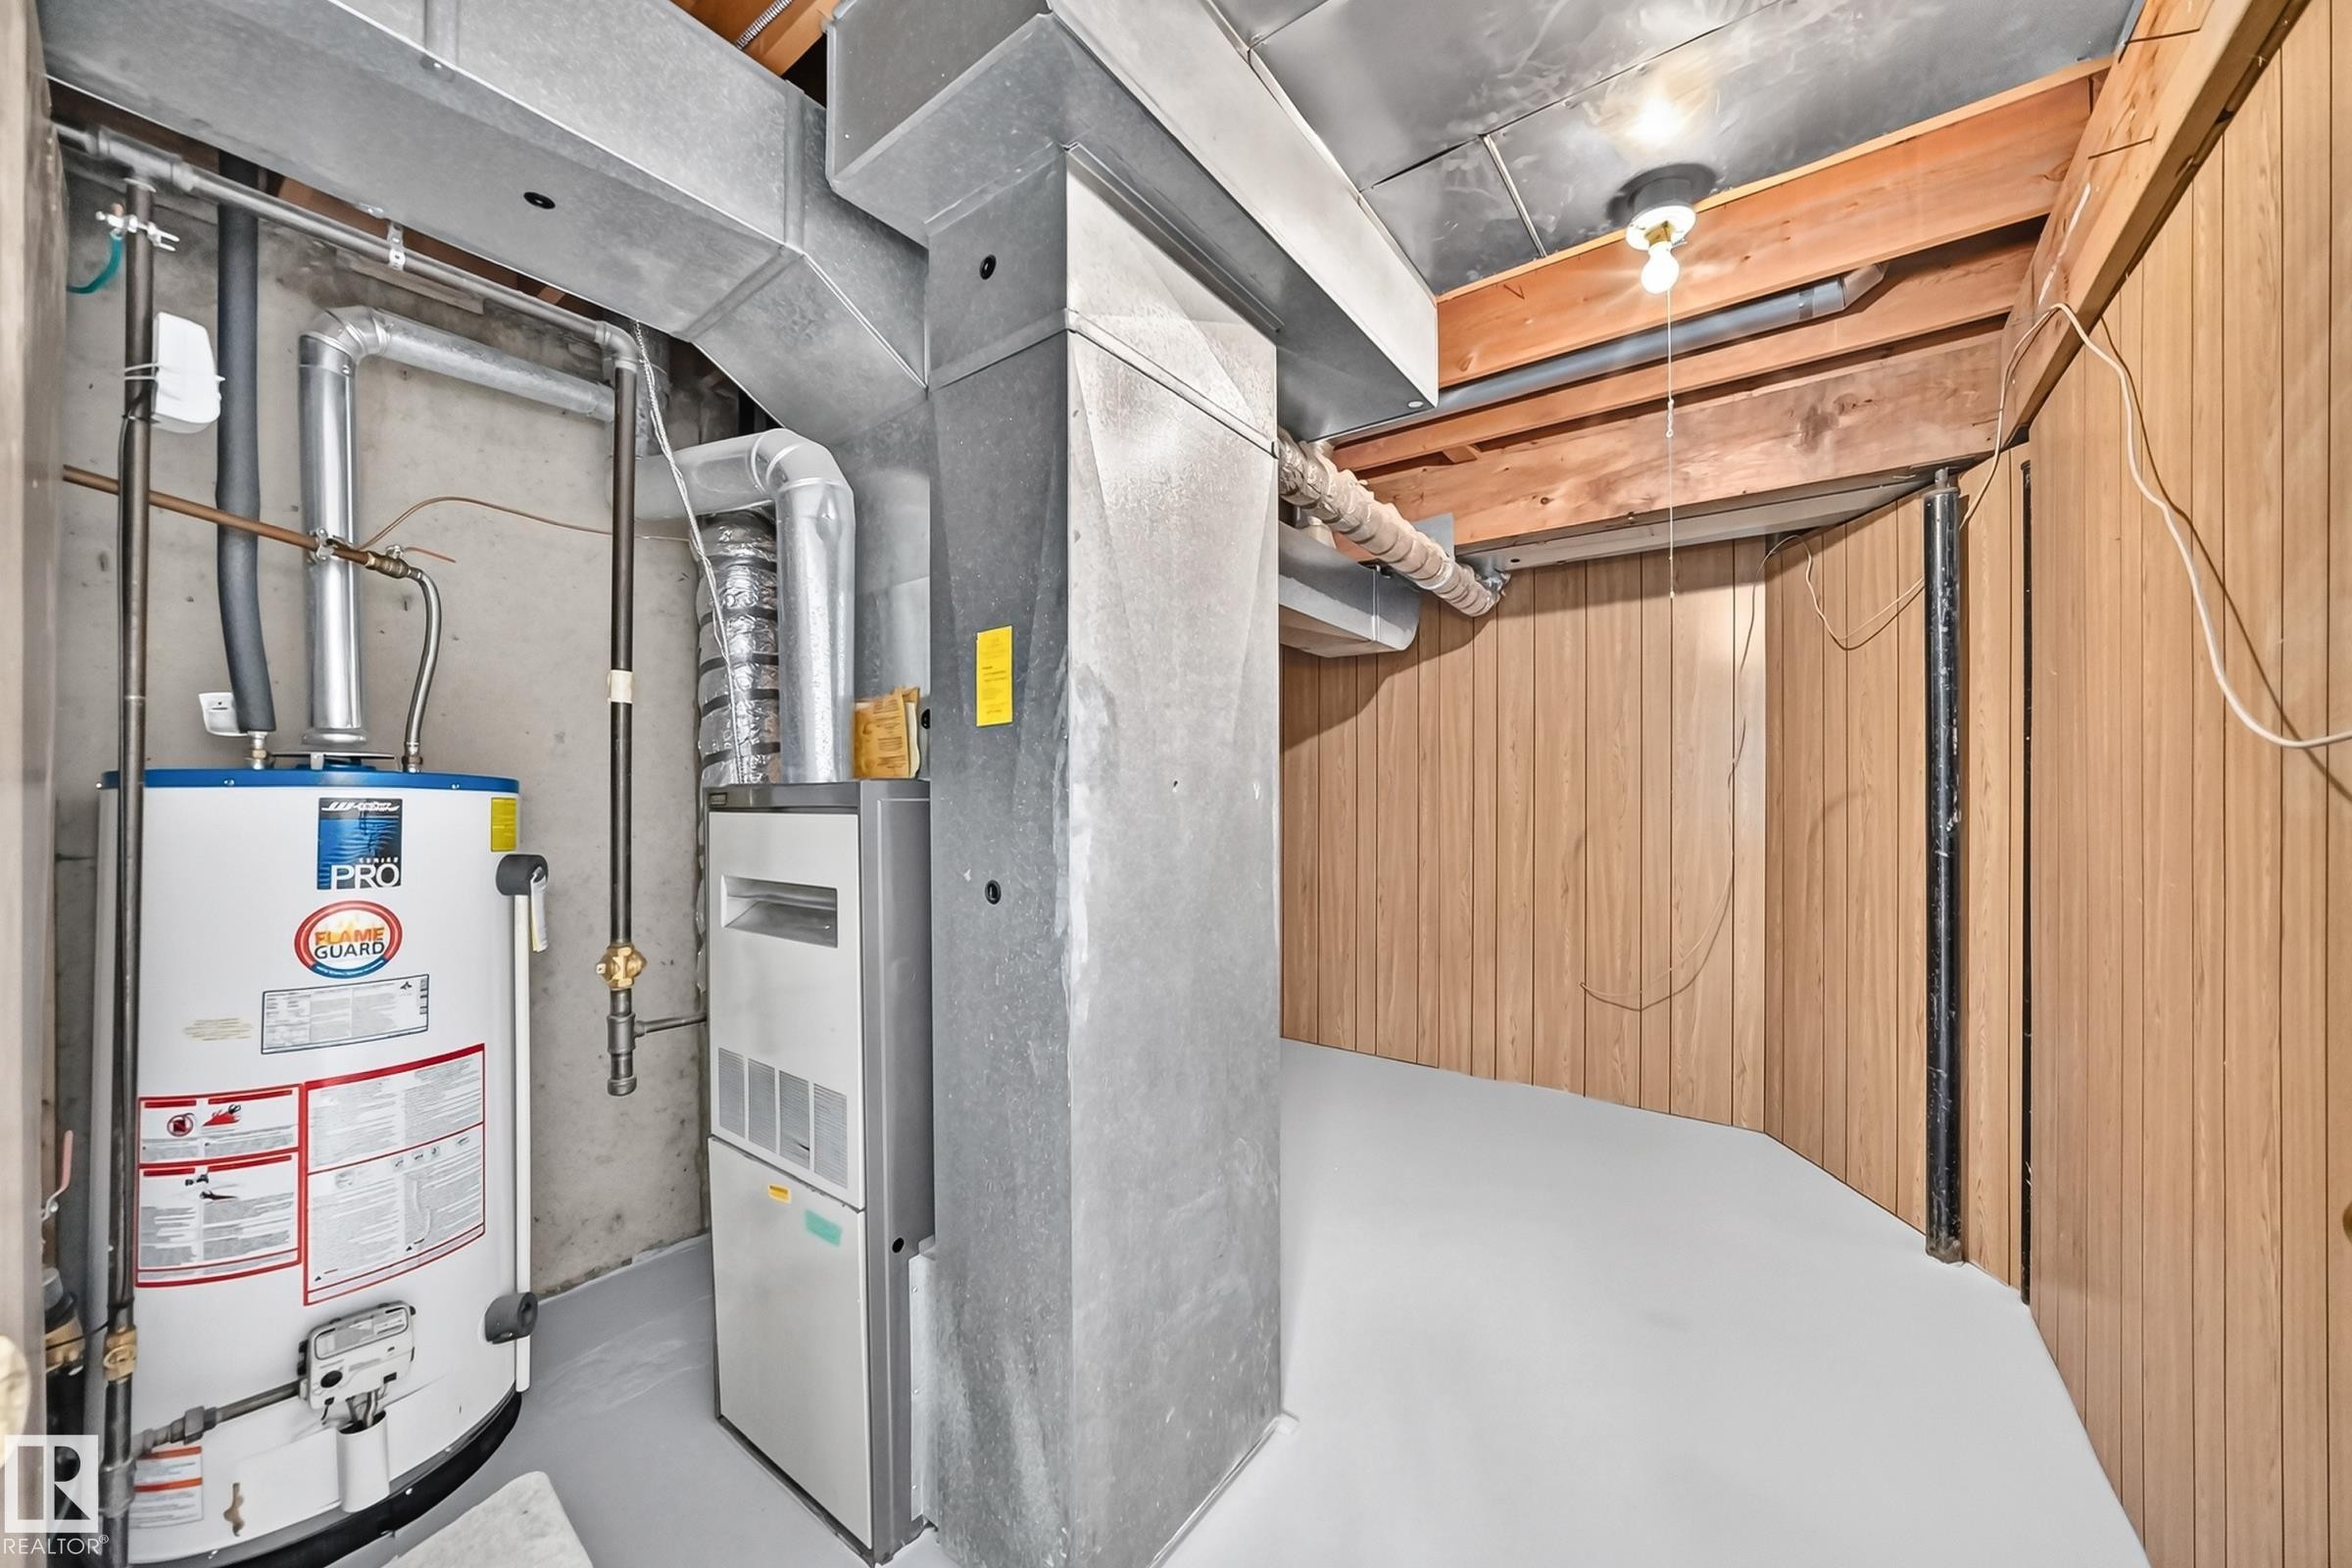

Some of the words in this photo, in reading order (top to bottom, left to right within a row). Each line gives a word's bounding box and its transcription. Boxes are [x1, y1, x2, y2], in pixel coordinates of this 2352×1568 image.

[331, 863, 400, 890] PRO
[315, 926, 385, 946] FLAME
[314, 941, 385, 959] GUARD
